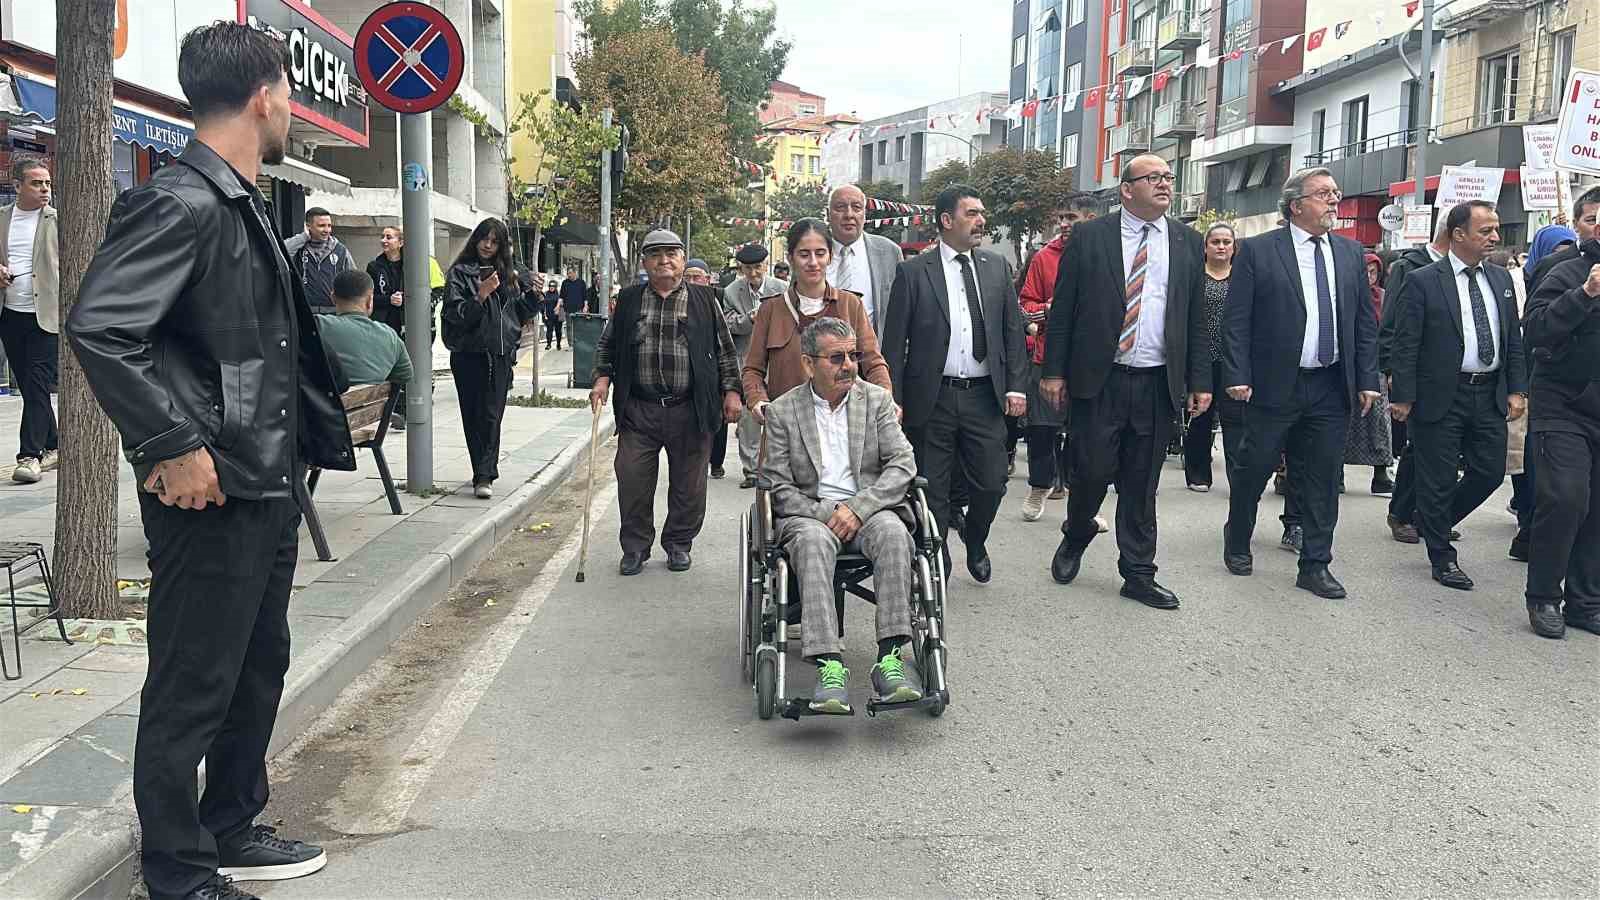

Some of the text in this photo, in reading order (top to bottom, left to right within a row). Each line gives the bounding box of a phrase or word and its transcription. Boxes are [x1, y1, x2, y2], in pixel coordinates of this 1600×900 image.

[289, 27, 347, 107] ÇİÇEK
[145, 120, 189, 149] İLETİŞİM
[1571, 144, 1600, 159] ONL
